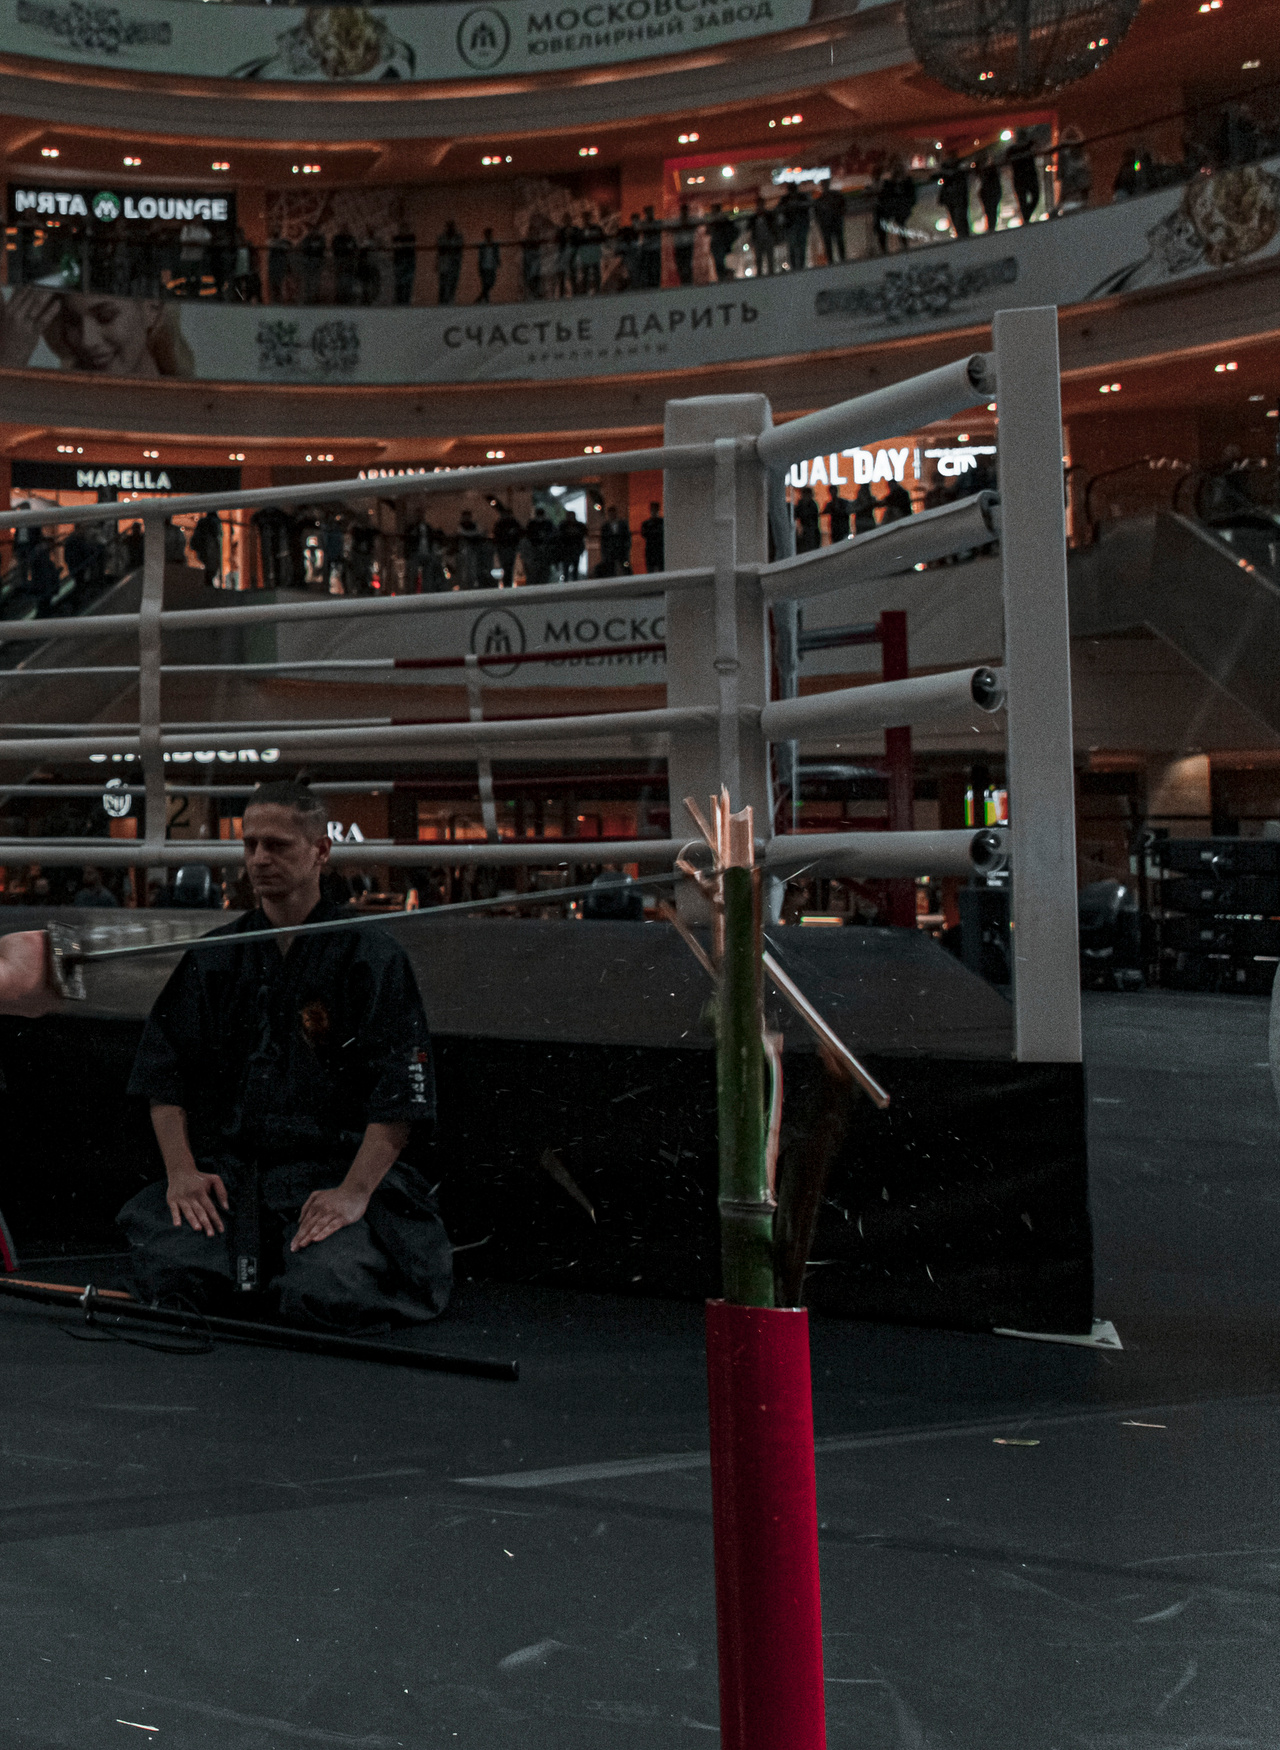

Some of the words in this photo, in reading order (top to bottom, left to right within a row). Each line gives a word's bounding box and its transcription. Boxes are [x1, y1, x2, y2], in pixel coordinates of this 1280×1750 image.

[526, 15, 684, 56] ЮВЕЛИРНЫЙ
[691, 1, 774, 33] ЗАВОД
[15, 189, 88, 217] МЯТА
[123, 196, 228, 221] LOUNGE
[442, 318, 593, 349] СЧАСТЬЕ
[614, 301, 759, 341] ДАРИТЬ
[76, 469, 172, 490] MARELLA
[852, 447, 910, 485] DAY
